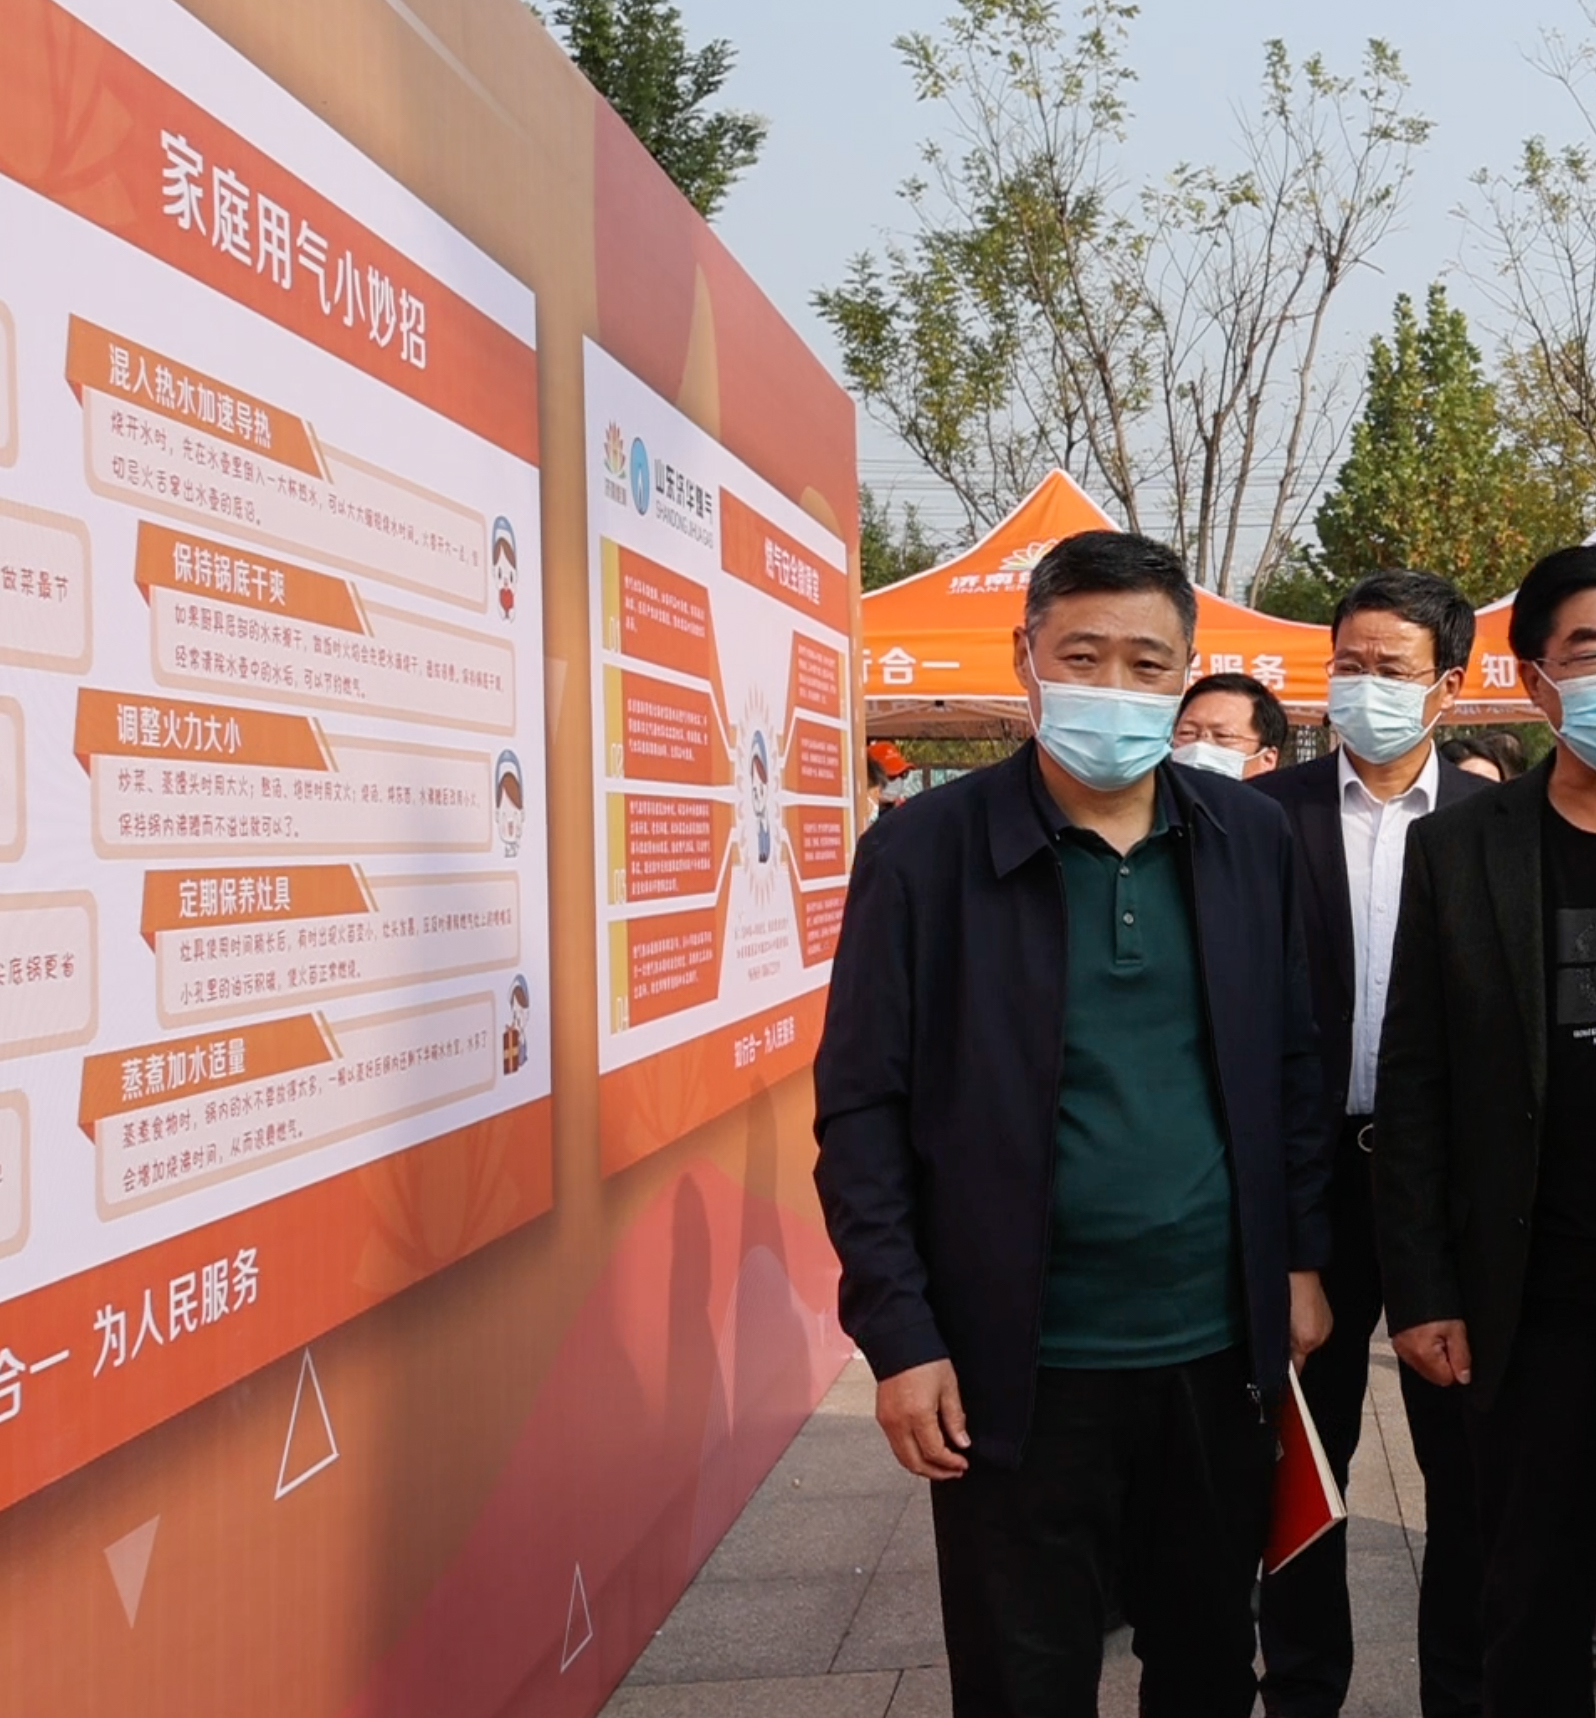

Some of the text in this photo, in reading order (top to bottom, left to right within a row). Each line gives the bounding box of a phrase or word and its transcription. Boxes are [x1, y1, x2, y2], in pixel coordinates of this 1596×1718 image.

[161, 129, 427, 370] 家庭用气小妙招
[173, 542, 287, 606] 保持锅底干爽
[1481, 653, 1516, 688] 知
[117, 703, 243, 754] 调整火力大小
[179, 876, 291, 919] 定期保养灶具
[121, 1037, 247, 1102] 蒸煮加水适量
[93, 1247, 260, 1378] 为人民服务
